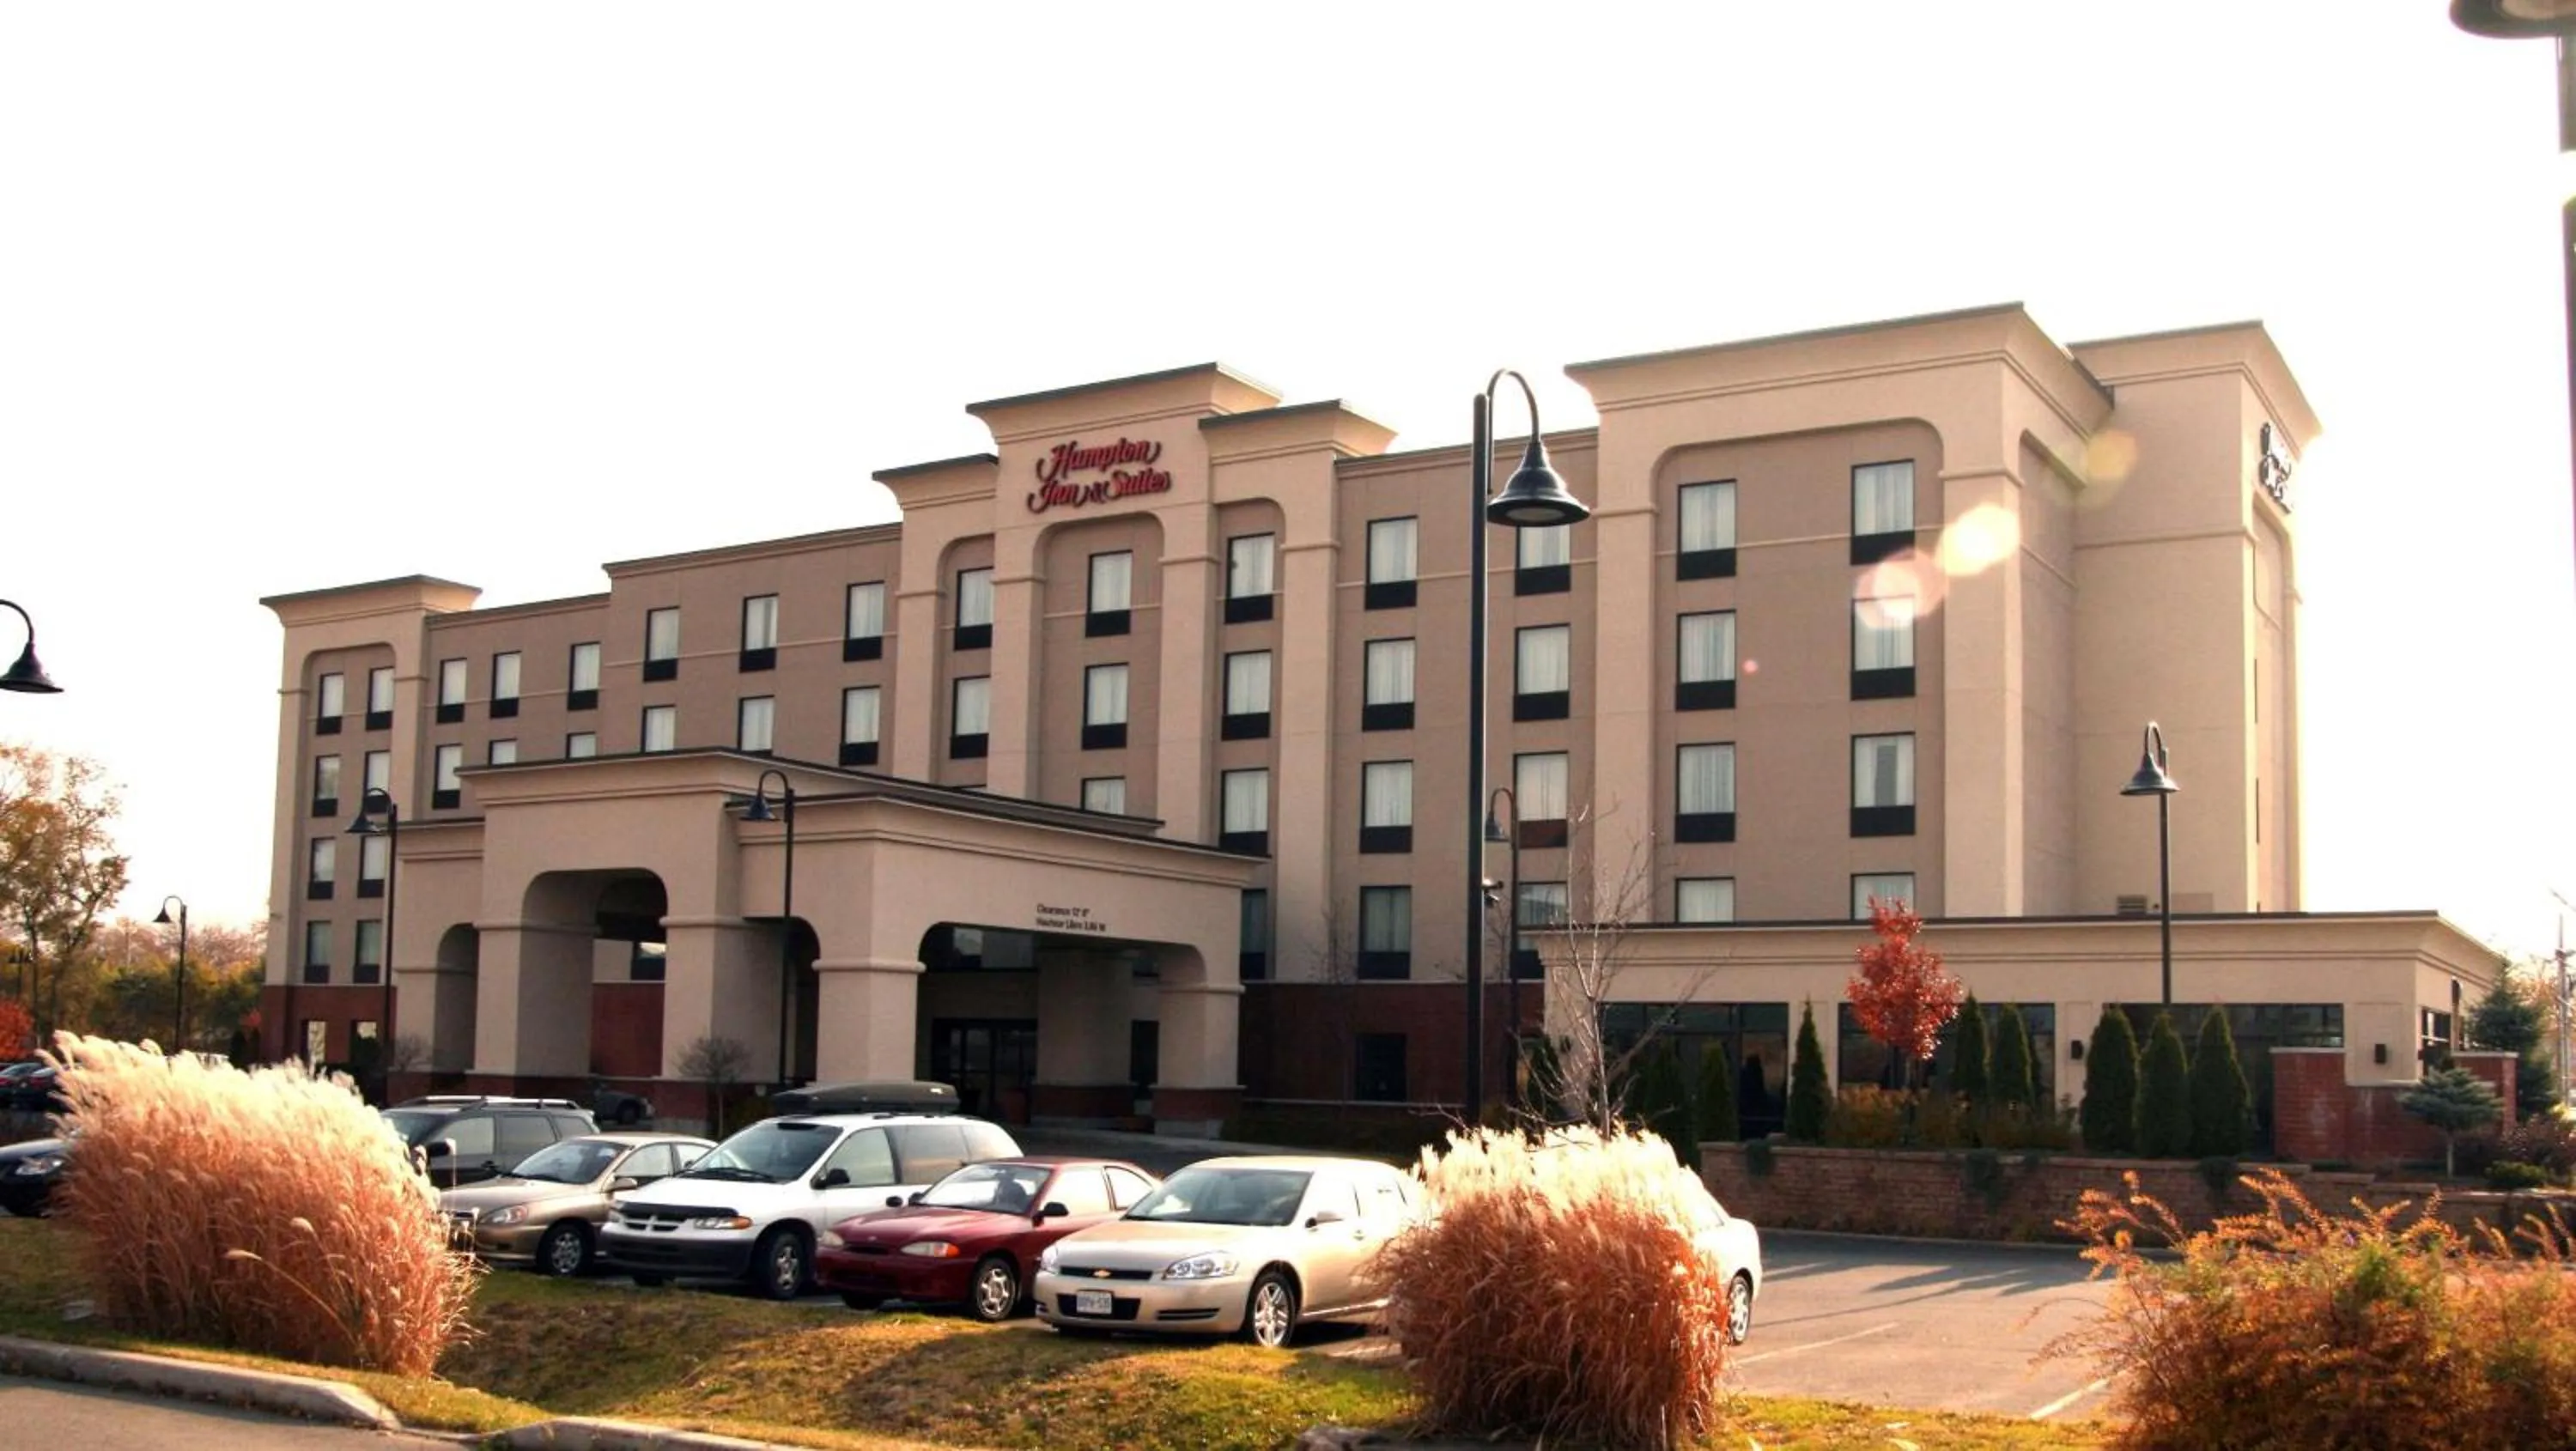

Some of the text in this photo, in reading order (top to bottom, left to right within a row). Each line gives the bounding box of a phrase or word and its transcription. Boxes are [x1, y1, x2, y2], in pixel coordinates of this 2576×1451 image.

[1036, 437, 1162, 483] Hampton
[1027, 479, 1091, 514] Inn
[1105, 467, 1172, 501] Suites
